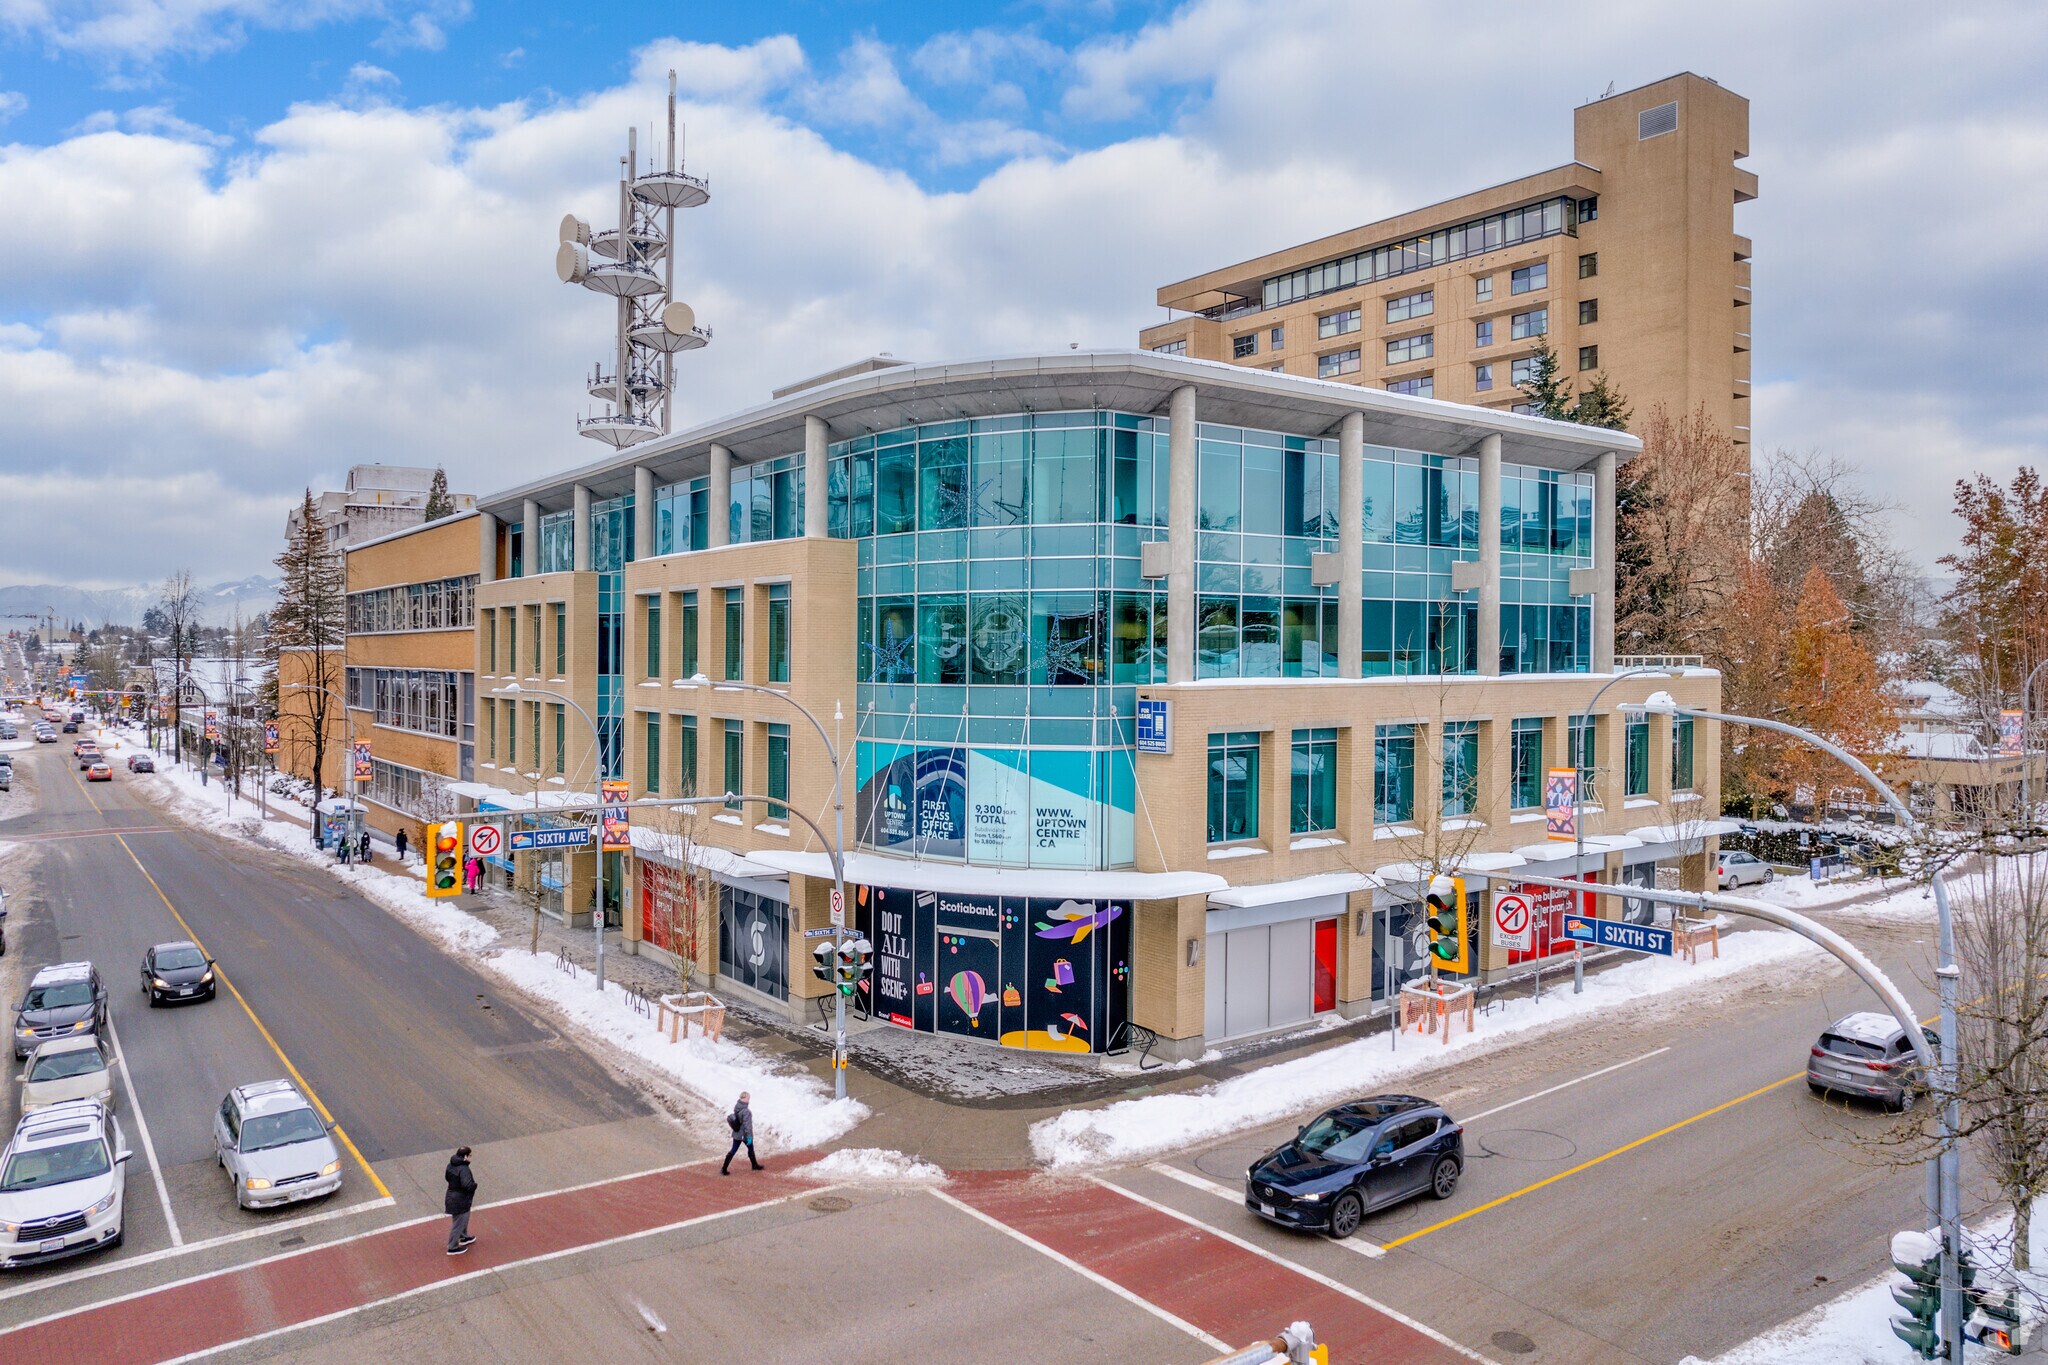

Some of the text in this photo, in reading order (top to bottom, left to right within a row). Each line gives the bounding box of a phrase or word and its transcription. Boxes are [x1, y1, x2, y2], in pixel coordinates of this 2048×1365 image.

[922, 800, 947, 810] FIRST
[975, 804, 1002, 814] 9,300
[605, 807, 627, 819] MY
[884, 811, 906, 820] UPTOWN
[922, 810, 950, 820] CLASS
[1036, 808, 1073, 818] WWW.
[885, 818, 904, 827] CENTRE
[975, 815, 1006, 825] TOTAL
[1036, 818, 1087, 828] UPTOWN
[922, 820, 954, 831] OFFICE
[537, 832, 566, 844] SIXTH
[568, 831, 587, 842] AVE
[922, 829, 950, 840] SPACE
[1036, 828, 1080, 838] CENTRE
[1036, 838, 1056, 848] .CA
[940, 900, 997, 917] Scotiabank.
[881, 911, 902, 935] DO IT
[1500, 933, 1522, 941] EXCEPT
[1605, 925, 1665, 950] SIXTH ST
[881, 934, 910, 959] ALL
[881, 955, 900, 979] WITH
[881, 976, 908, 1000] SCENE+
